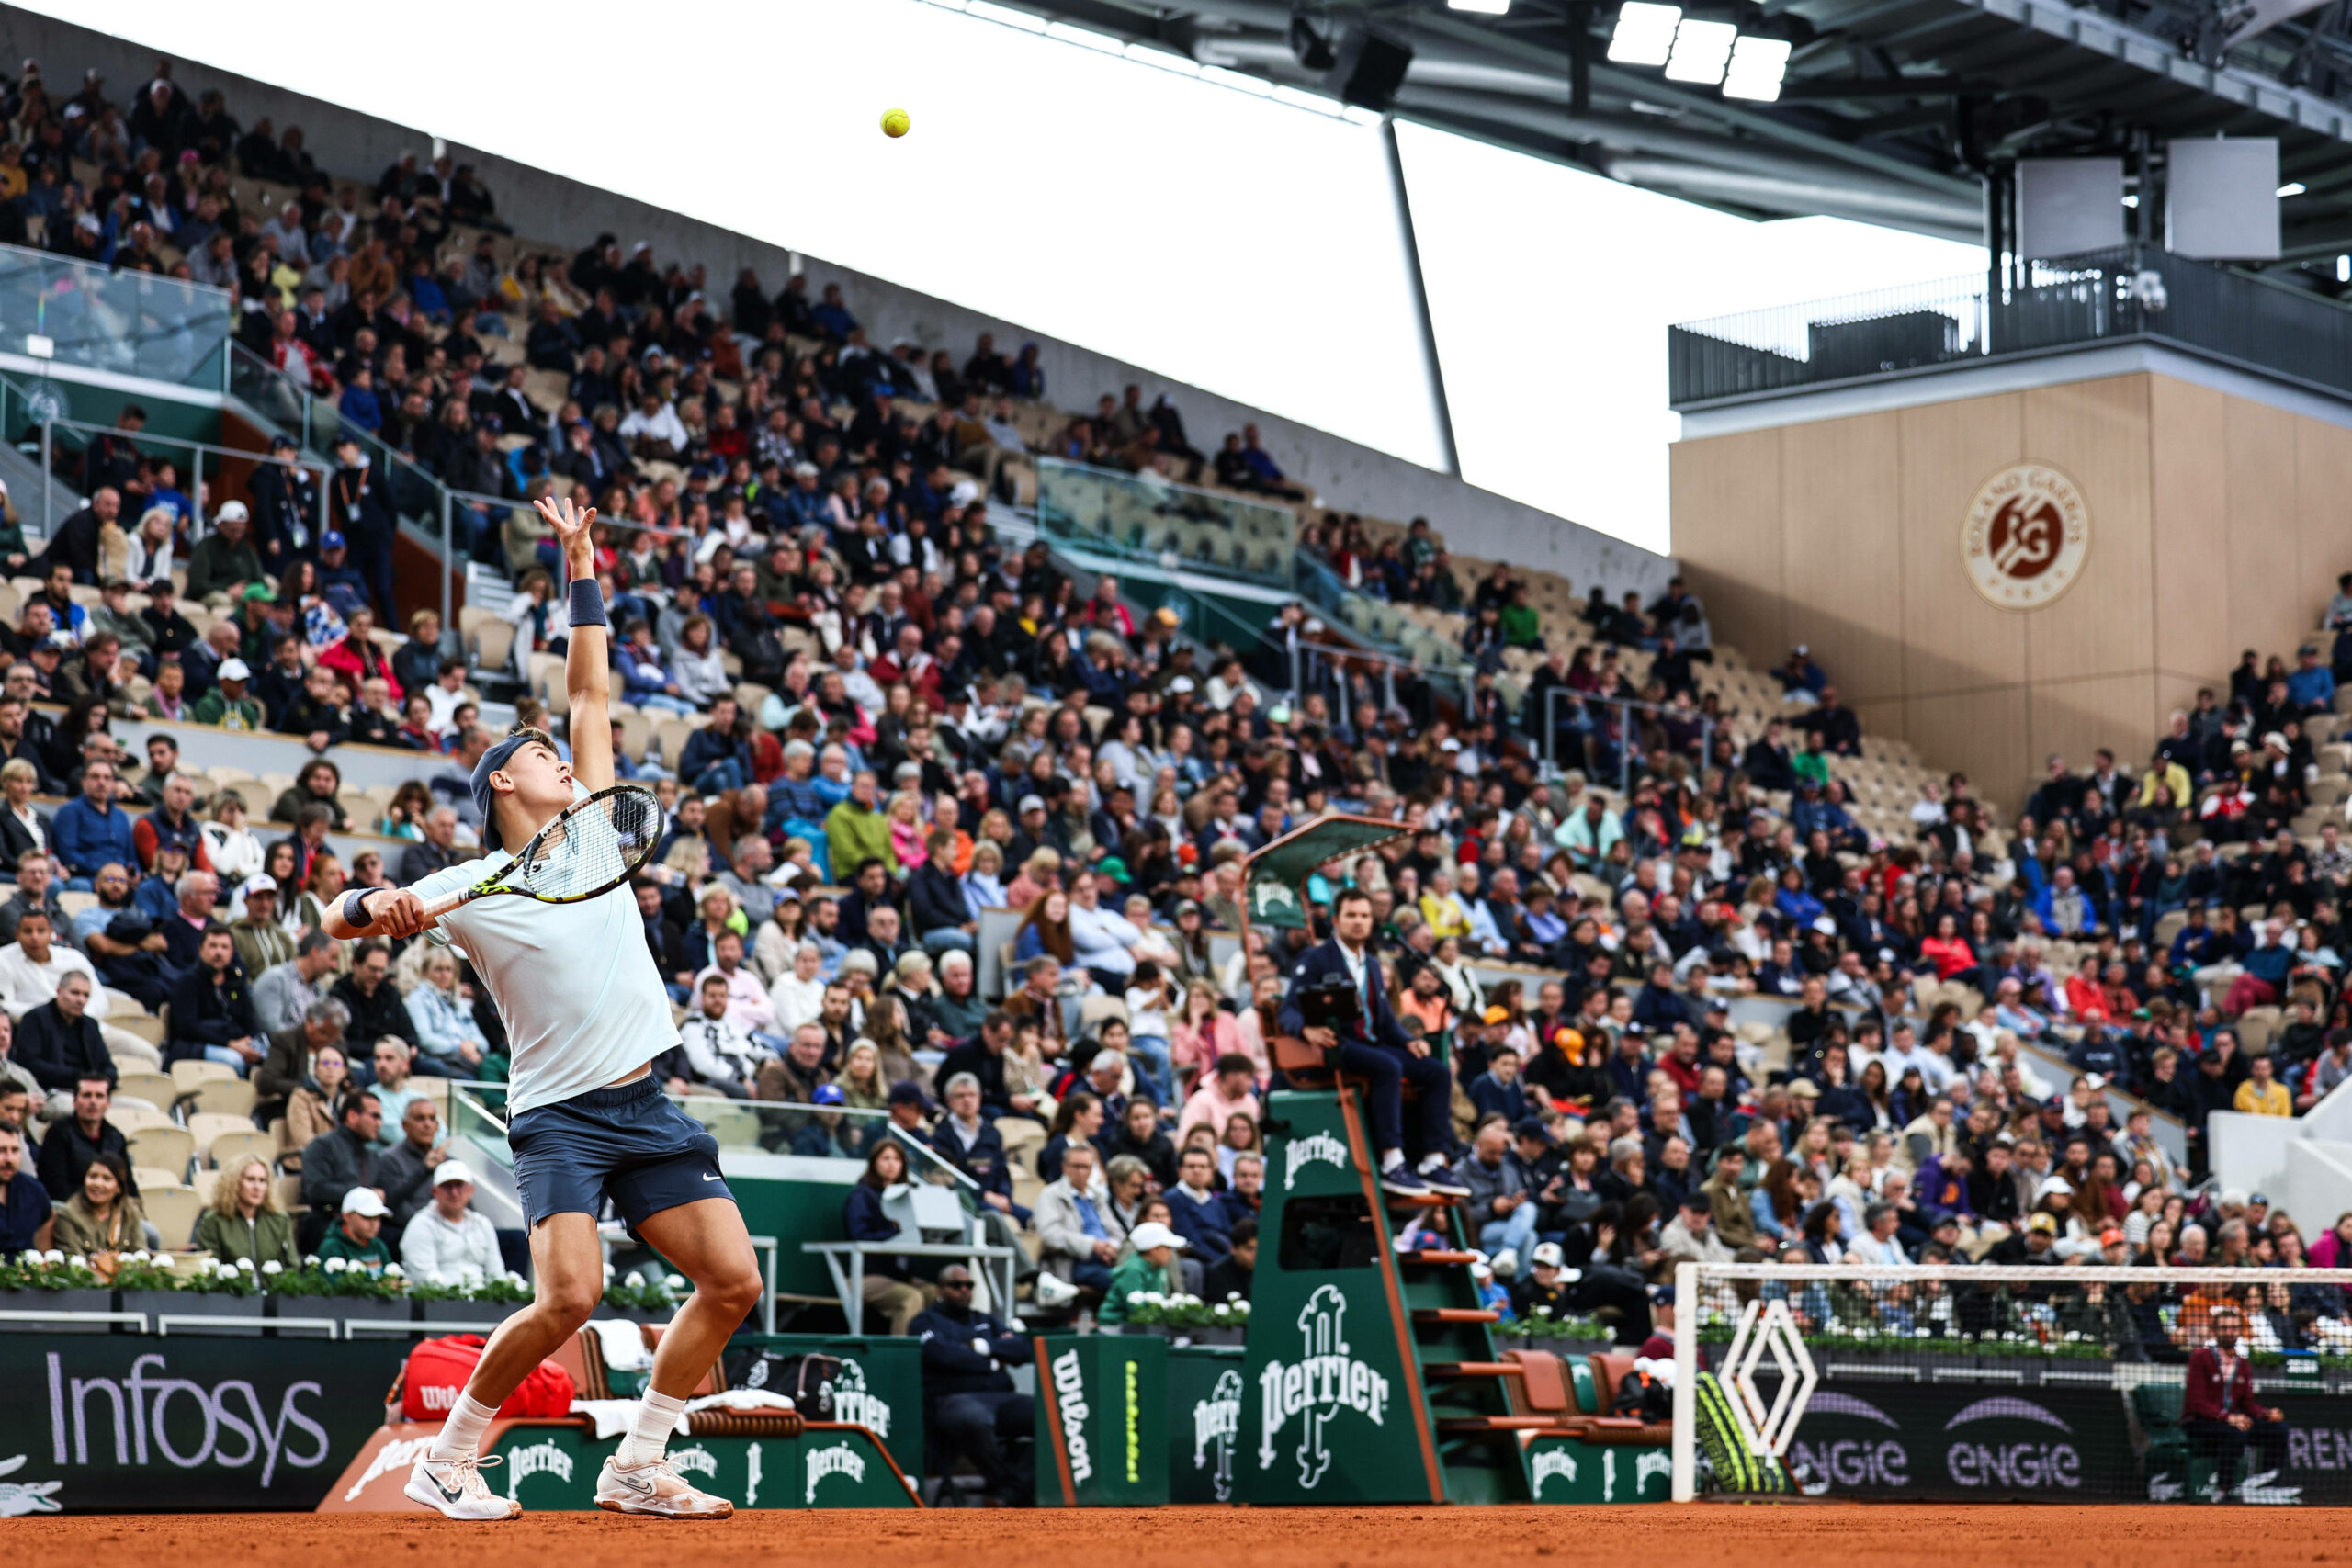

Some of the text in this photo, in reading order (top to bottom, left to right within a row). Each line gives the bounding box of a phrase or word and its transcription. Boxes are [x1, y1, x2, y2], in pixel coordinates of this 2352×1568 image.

[46, 1351, 330, 1487] Infosys
[419, 1384, 460, 1410] Wil
[1052, 1348, 1092, 1488] Wilson
